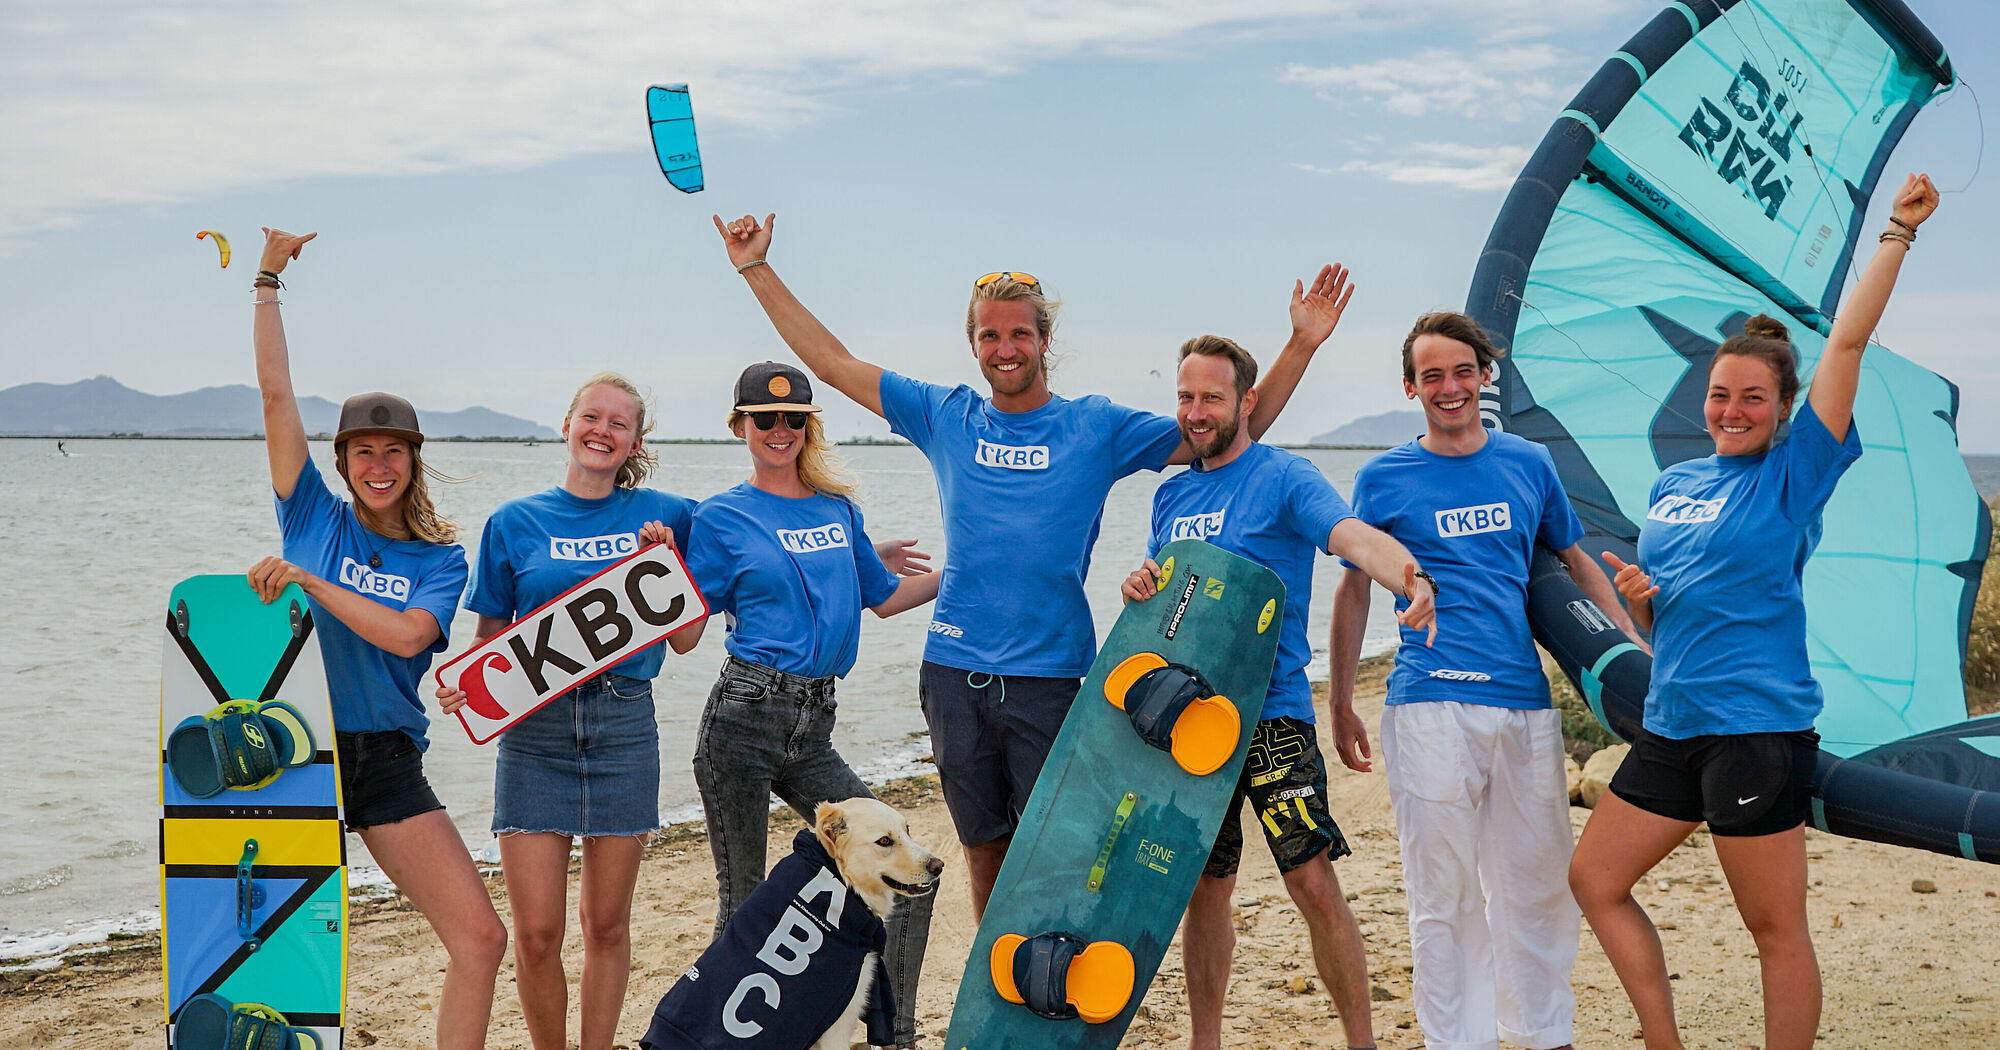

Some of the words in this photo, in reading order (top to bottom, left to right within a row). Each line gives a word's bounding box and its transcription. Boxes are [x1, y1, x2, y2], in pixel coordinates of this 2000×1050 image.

[1625, 172, 1671, 210] BANDIT
[995, 448, 1044, 467] KBC
[1456, 507, 1506, 532] KBC
[574, 537, 633, 557] KBC
[795, 527, 844, 549] KBC
[359, 570, 406, 596] KBC
[1170, 576, 1197, 631] PROLIMIT
[508, 560, 686, 697] KBC
[1138, 839, 1176, 863] F-ONE
